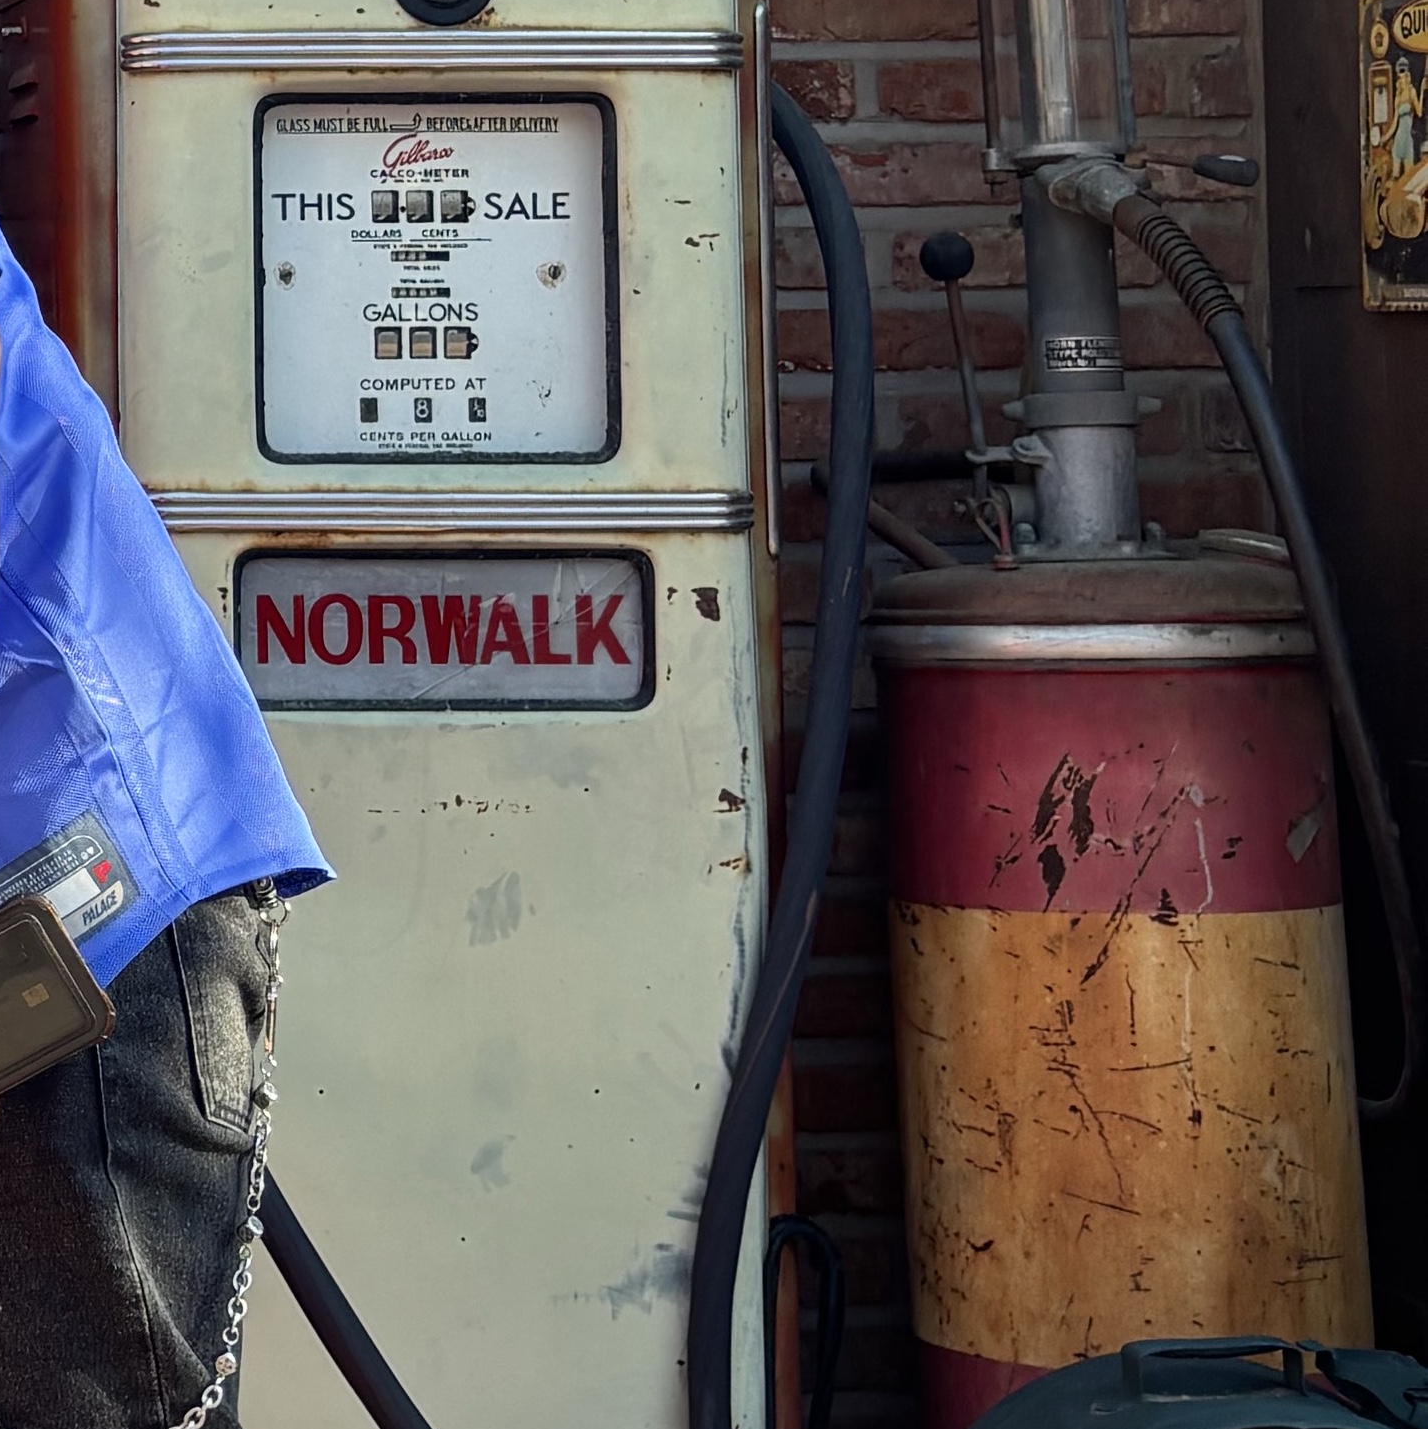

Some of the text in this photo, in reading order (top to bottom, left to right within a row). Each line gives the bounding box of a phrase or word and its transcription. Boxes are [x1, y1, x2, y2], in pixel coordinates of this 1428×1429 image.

[1400, 9, 1428, 39] QUI
[276, 118, 389, 133] GLASS MUST BE FULL
[473, 117, 507, 132] AFTER
[509, 117, 559, 132] DELIVERY
[271, 192, 572, 221] THIS SALE
[351, 229, 459, 238] DOLLARS CENTS
[363, 303, 479, 322] GALLONS
[360, 377, 487, 391] COMPUTED AT
[416, 399, 429, 418] 8
[359, 431, 492, 441] CENTS PER GALLON
[255, 594, 632, 665] NORWALK
[82, 890, 118, 926] PALACE
